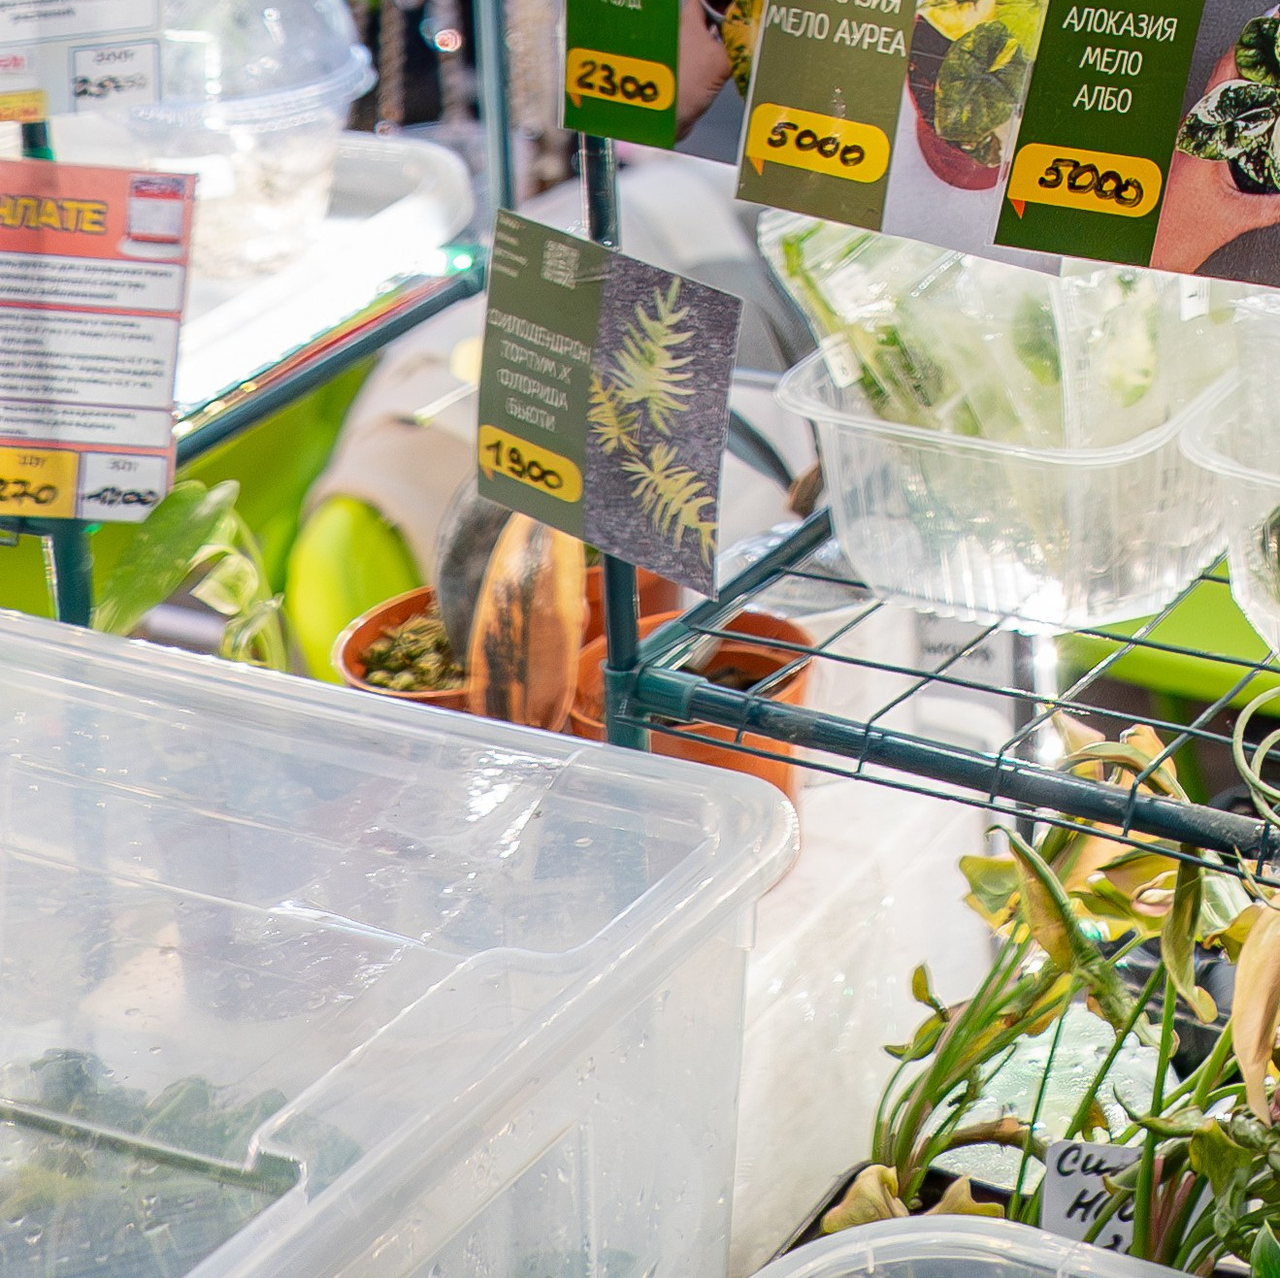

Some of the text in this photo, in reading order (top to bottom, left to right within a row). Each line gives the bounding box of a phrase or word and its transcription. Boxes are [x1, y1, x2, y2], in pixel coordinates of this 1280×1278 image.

[766, 4, 907, 57] МЕЛО АУРЕА
[1062, 6, 1178, 42] АЛОКАЗИЯ
[577, 60, 659, 103] 2300
[1079, 46, 1143, 76] МЕЛО
[1073, 83, 1132, 113] АЛБО
[766, 121, 865, 168] 5000
[1038, 157, 1144, 209] 5000
[486, 438, 564, 490] 1900
